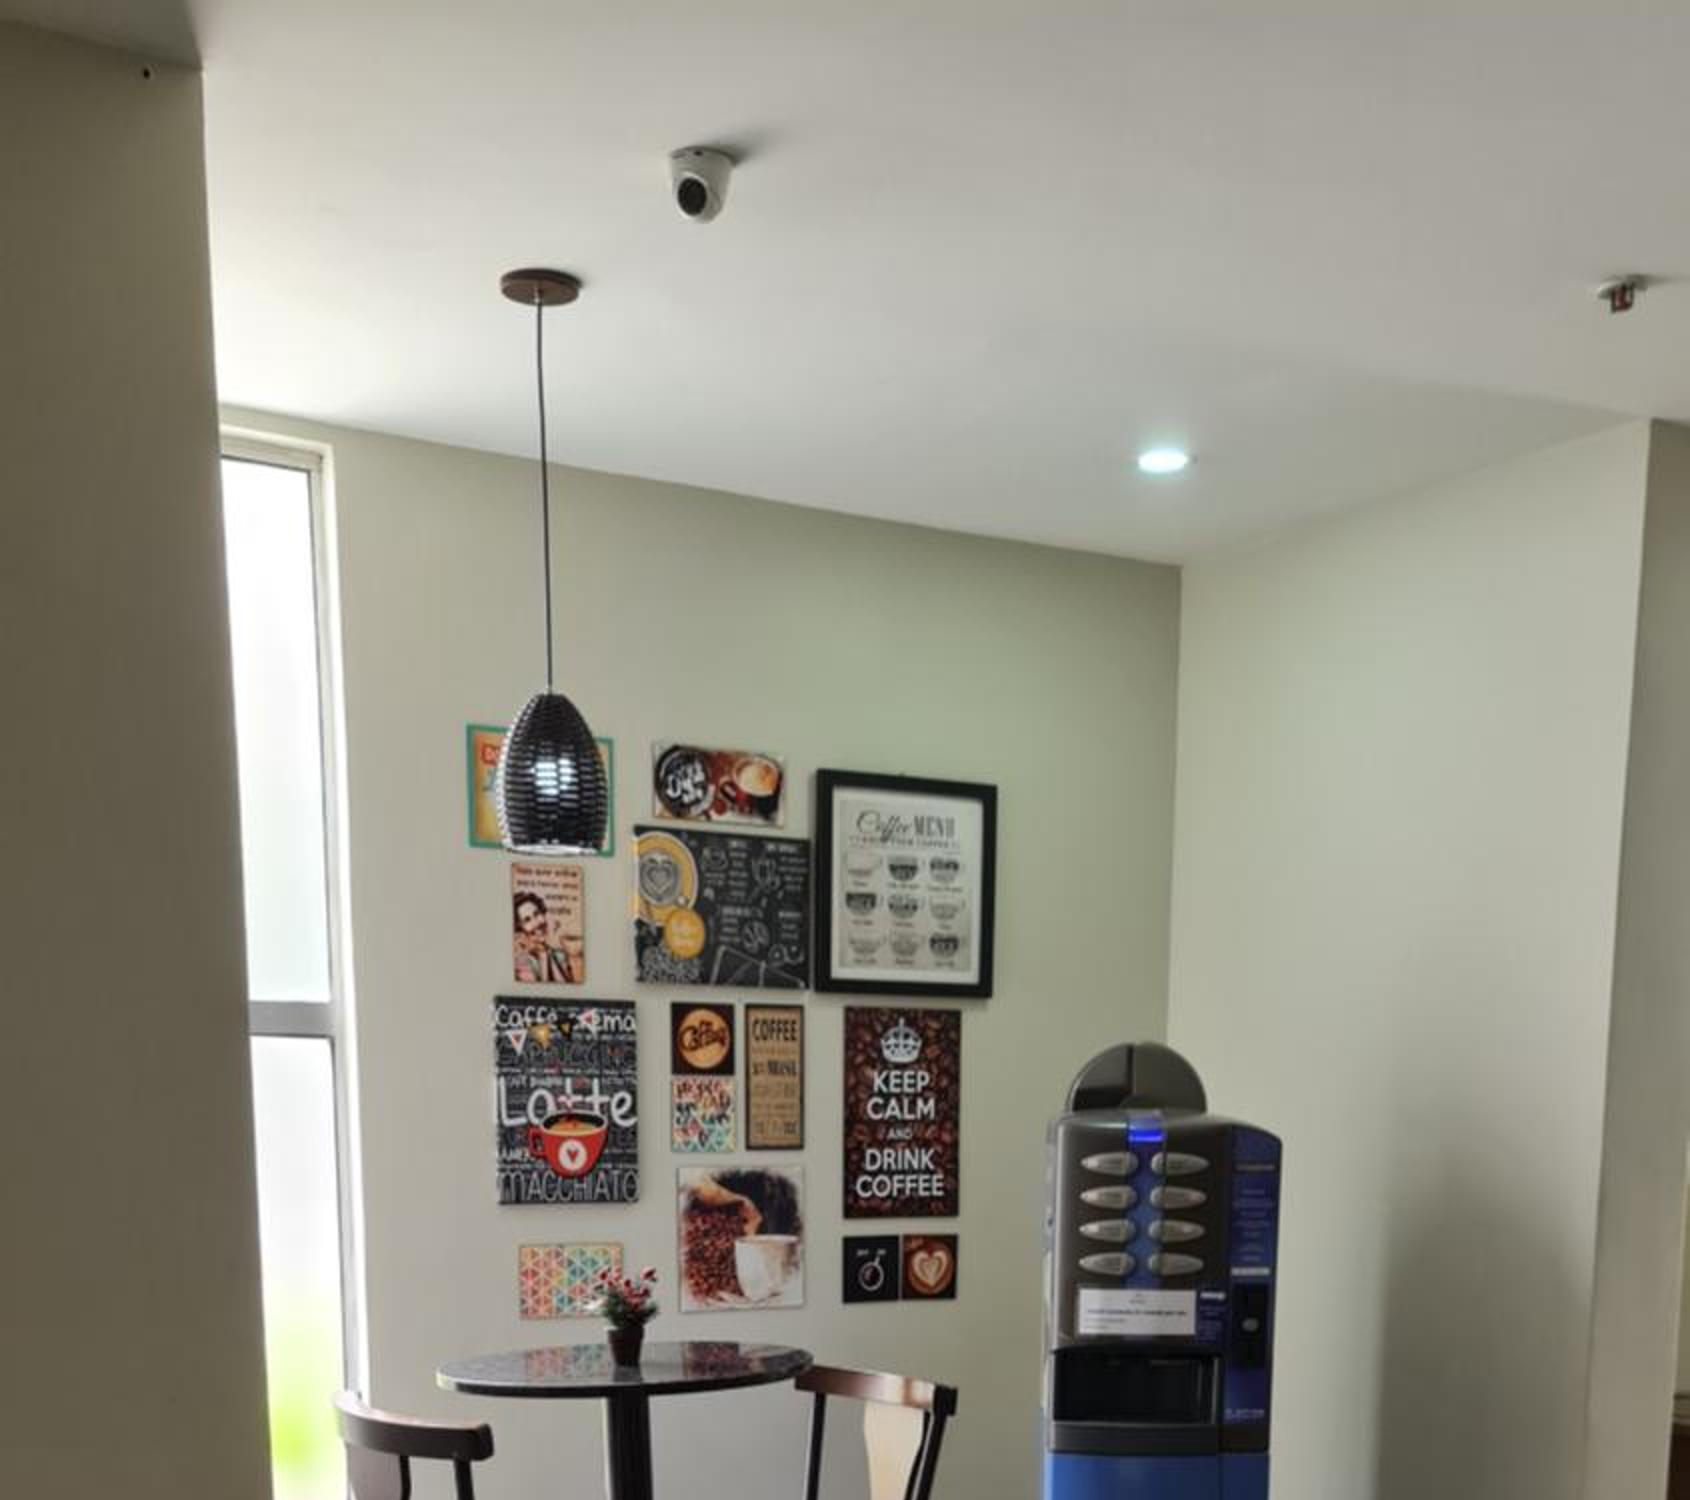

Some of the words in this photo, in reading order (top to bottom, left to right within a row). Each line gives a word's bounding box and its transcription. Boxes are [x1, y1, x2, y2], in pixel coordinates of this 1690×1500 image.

[753, 1018, 797, 1041] COFFEE
[873, 1070, 930, 1093] KEEP
[499, 1077, 638, 1126] Latte
[866, 1097, 935, 1119] CALM
[887, 1129, 912, 1139] AND
[865, 1148, 935, 1171] DRINK
[500, 1169, 639, 1201] MACCHIATO
[856, 1175, 944, 1197] COFFEE
